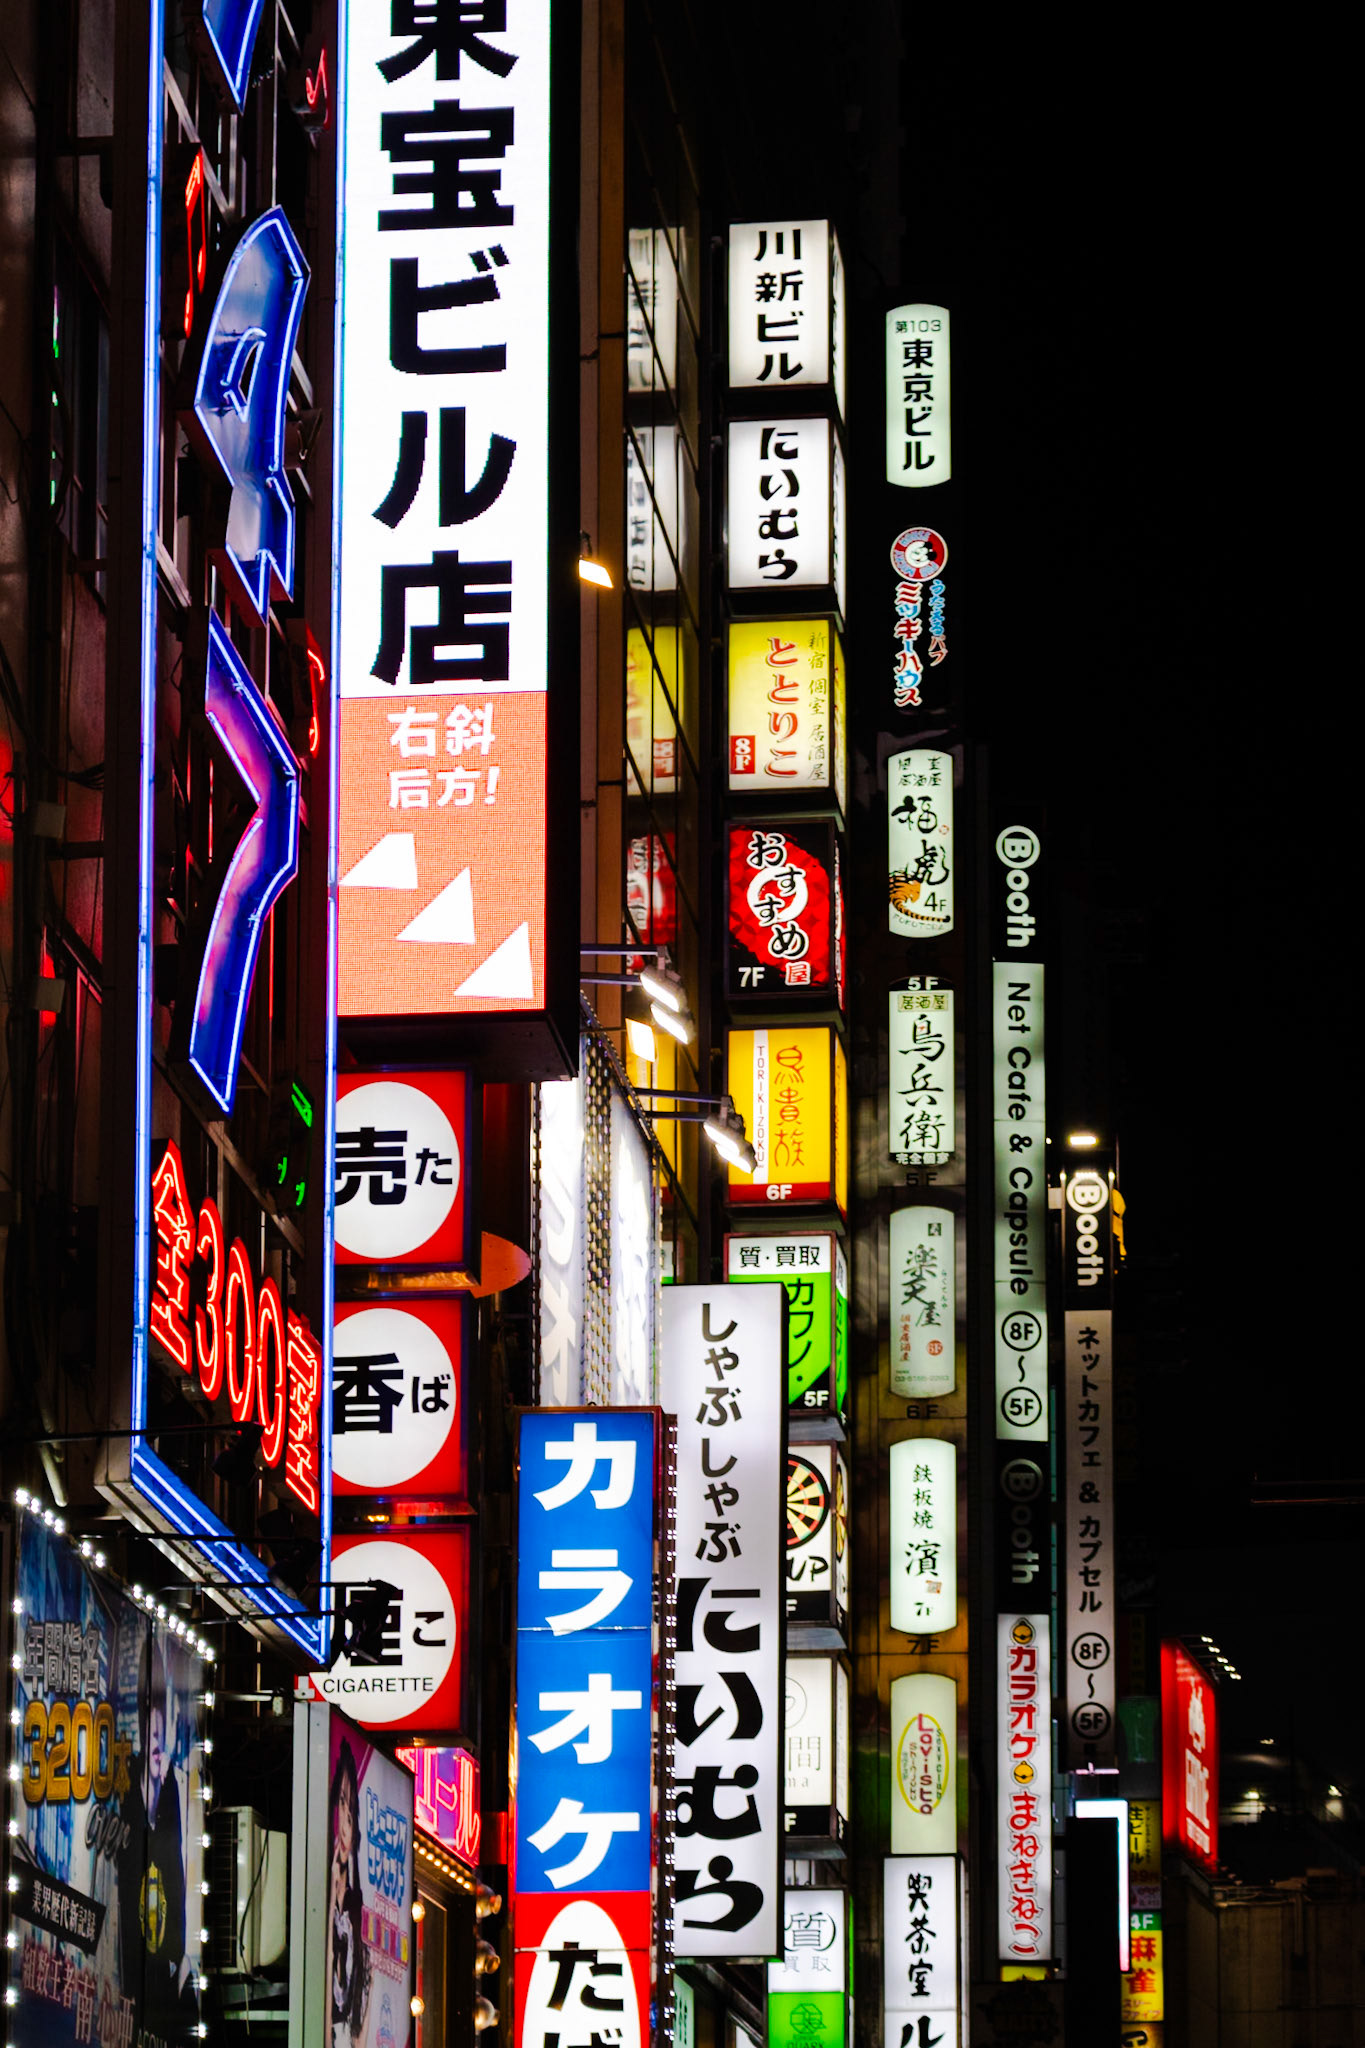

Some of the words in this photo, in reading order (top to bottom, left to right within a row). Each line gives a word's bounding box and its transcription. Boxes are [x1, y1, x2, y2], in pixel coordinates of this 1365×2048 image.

[755, 229, 804, 381] 川新ビル
[895, 319, 942, 333] 第103
[902, 339, 935, 471] 東京ビル
[758, 427, 800, 580] にいむら
[387, 702, 496, 758] 右斜
[764, 637, 800, 777] ととりこ
[924, 892, 947, 912] 4F
[996, 825, 1040, 948] Booth
[738, 967, 765, 987] 7F
[1007, 982, 1031, 1034] Net
[757, 1046, 765, 1161] TORIKIZOKU
[1008, 1046, 1031, 1120] Cafe
[766, 1184, 792, 1200] 6F
[1009, 1133, 1033, 1153] &
[901, 1244, 942, 1327] 楽天屋
[1004, 1166, 1033, 1295] Capsule
[1066, 1173, 1109, 1287] Booth
[695, 1302, 742, 1563] しゃぶしゃぶ
[804, 1390, 829, 1407] 5F
[1077, 1326, 1101, 1468] ネットカフェ
[1079, 1481, 1100, 1504] &
[323, 1677, 434, 1693] CIGARETTE
[526, 1422, 642, 1890] カラオケ
[1009, 1646, 1037, 1759] カラオケ
[674, 1577, 764, 1932] にいむら
[1009, 1790, 1041, 1955] まねきねこ
[544, 1942, 624, 2048] た
